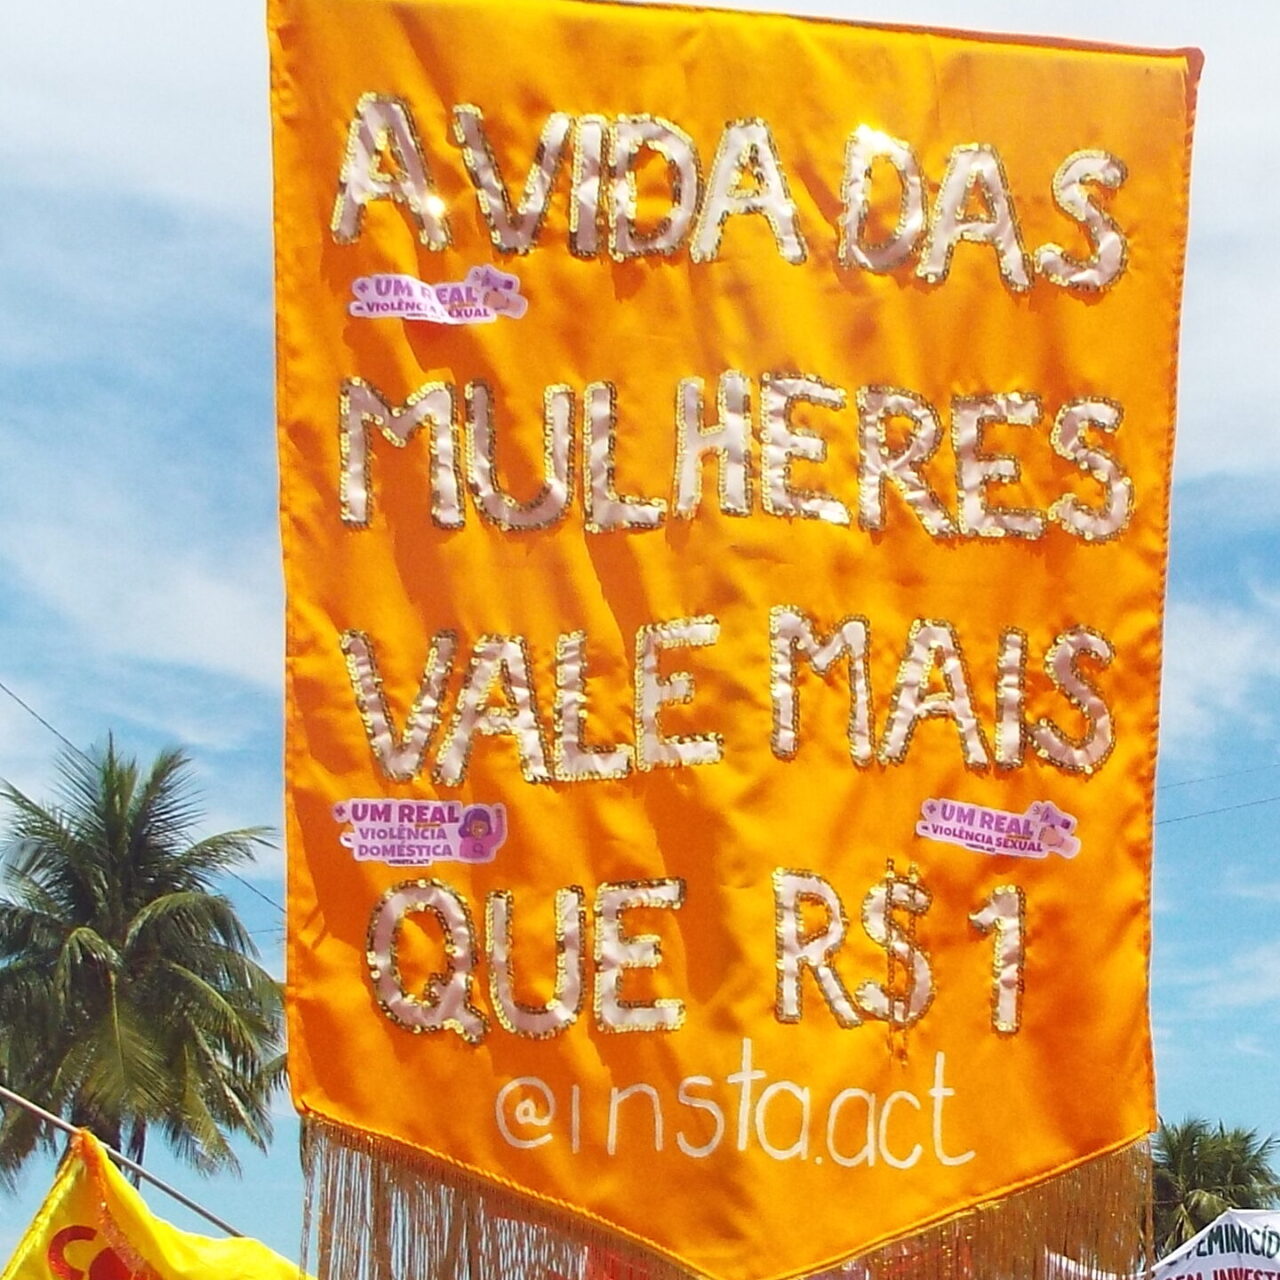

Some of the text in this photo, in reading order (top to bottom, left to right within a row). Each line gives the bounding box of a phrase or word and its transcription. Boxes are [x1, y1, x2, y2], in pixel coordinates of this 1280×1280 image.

[840, 125, 1129, 293] DAS
[375, 279, 413, 297] UM
[338, 367, 1137, 545] MULHERES
[338, 605, 1115, 789] VALE MAIS
[352, 804, 391, 822] UM
[398, 805, 460, 823] REAL
[941, 804, 975, 826] UM
[979, 812, 1034, 836] REAL
[359, 825, 447, 840] VIOLÊNCIA
[931, 823, 993, 845] VIOLÊNCIA
[995, 837, 1043, 852] SEXUAL
[358, 842, 453, 858] DOMÉSTICA
[367, 877, 688, 1045] QUE
[496, 1037, 977, 1170] @insta.act
